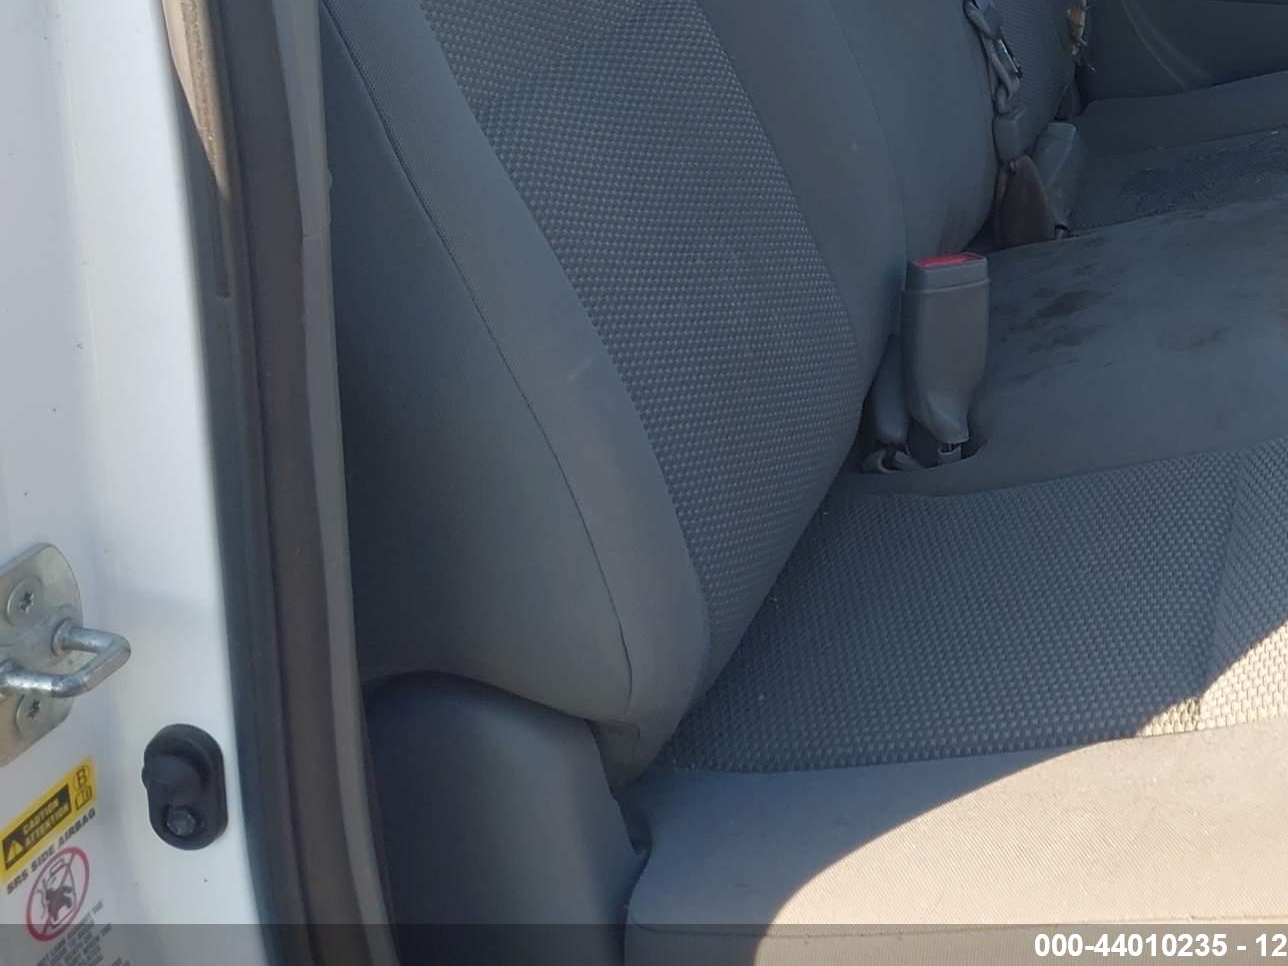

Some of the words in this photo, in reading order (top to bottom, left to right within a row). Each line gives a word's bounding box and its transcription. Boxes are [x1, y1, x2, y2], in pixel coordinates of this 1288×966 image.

[22, 796, 60, 836] CAUTION
[6, 870, 29, 895] SRS
[29, 845, 55, 874] SIDE
[57, 807, 96, 847] AIRBAG
